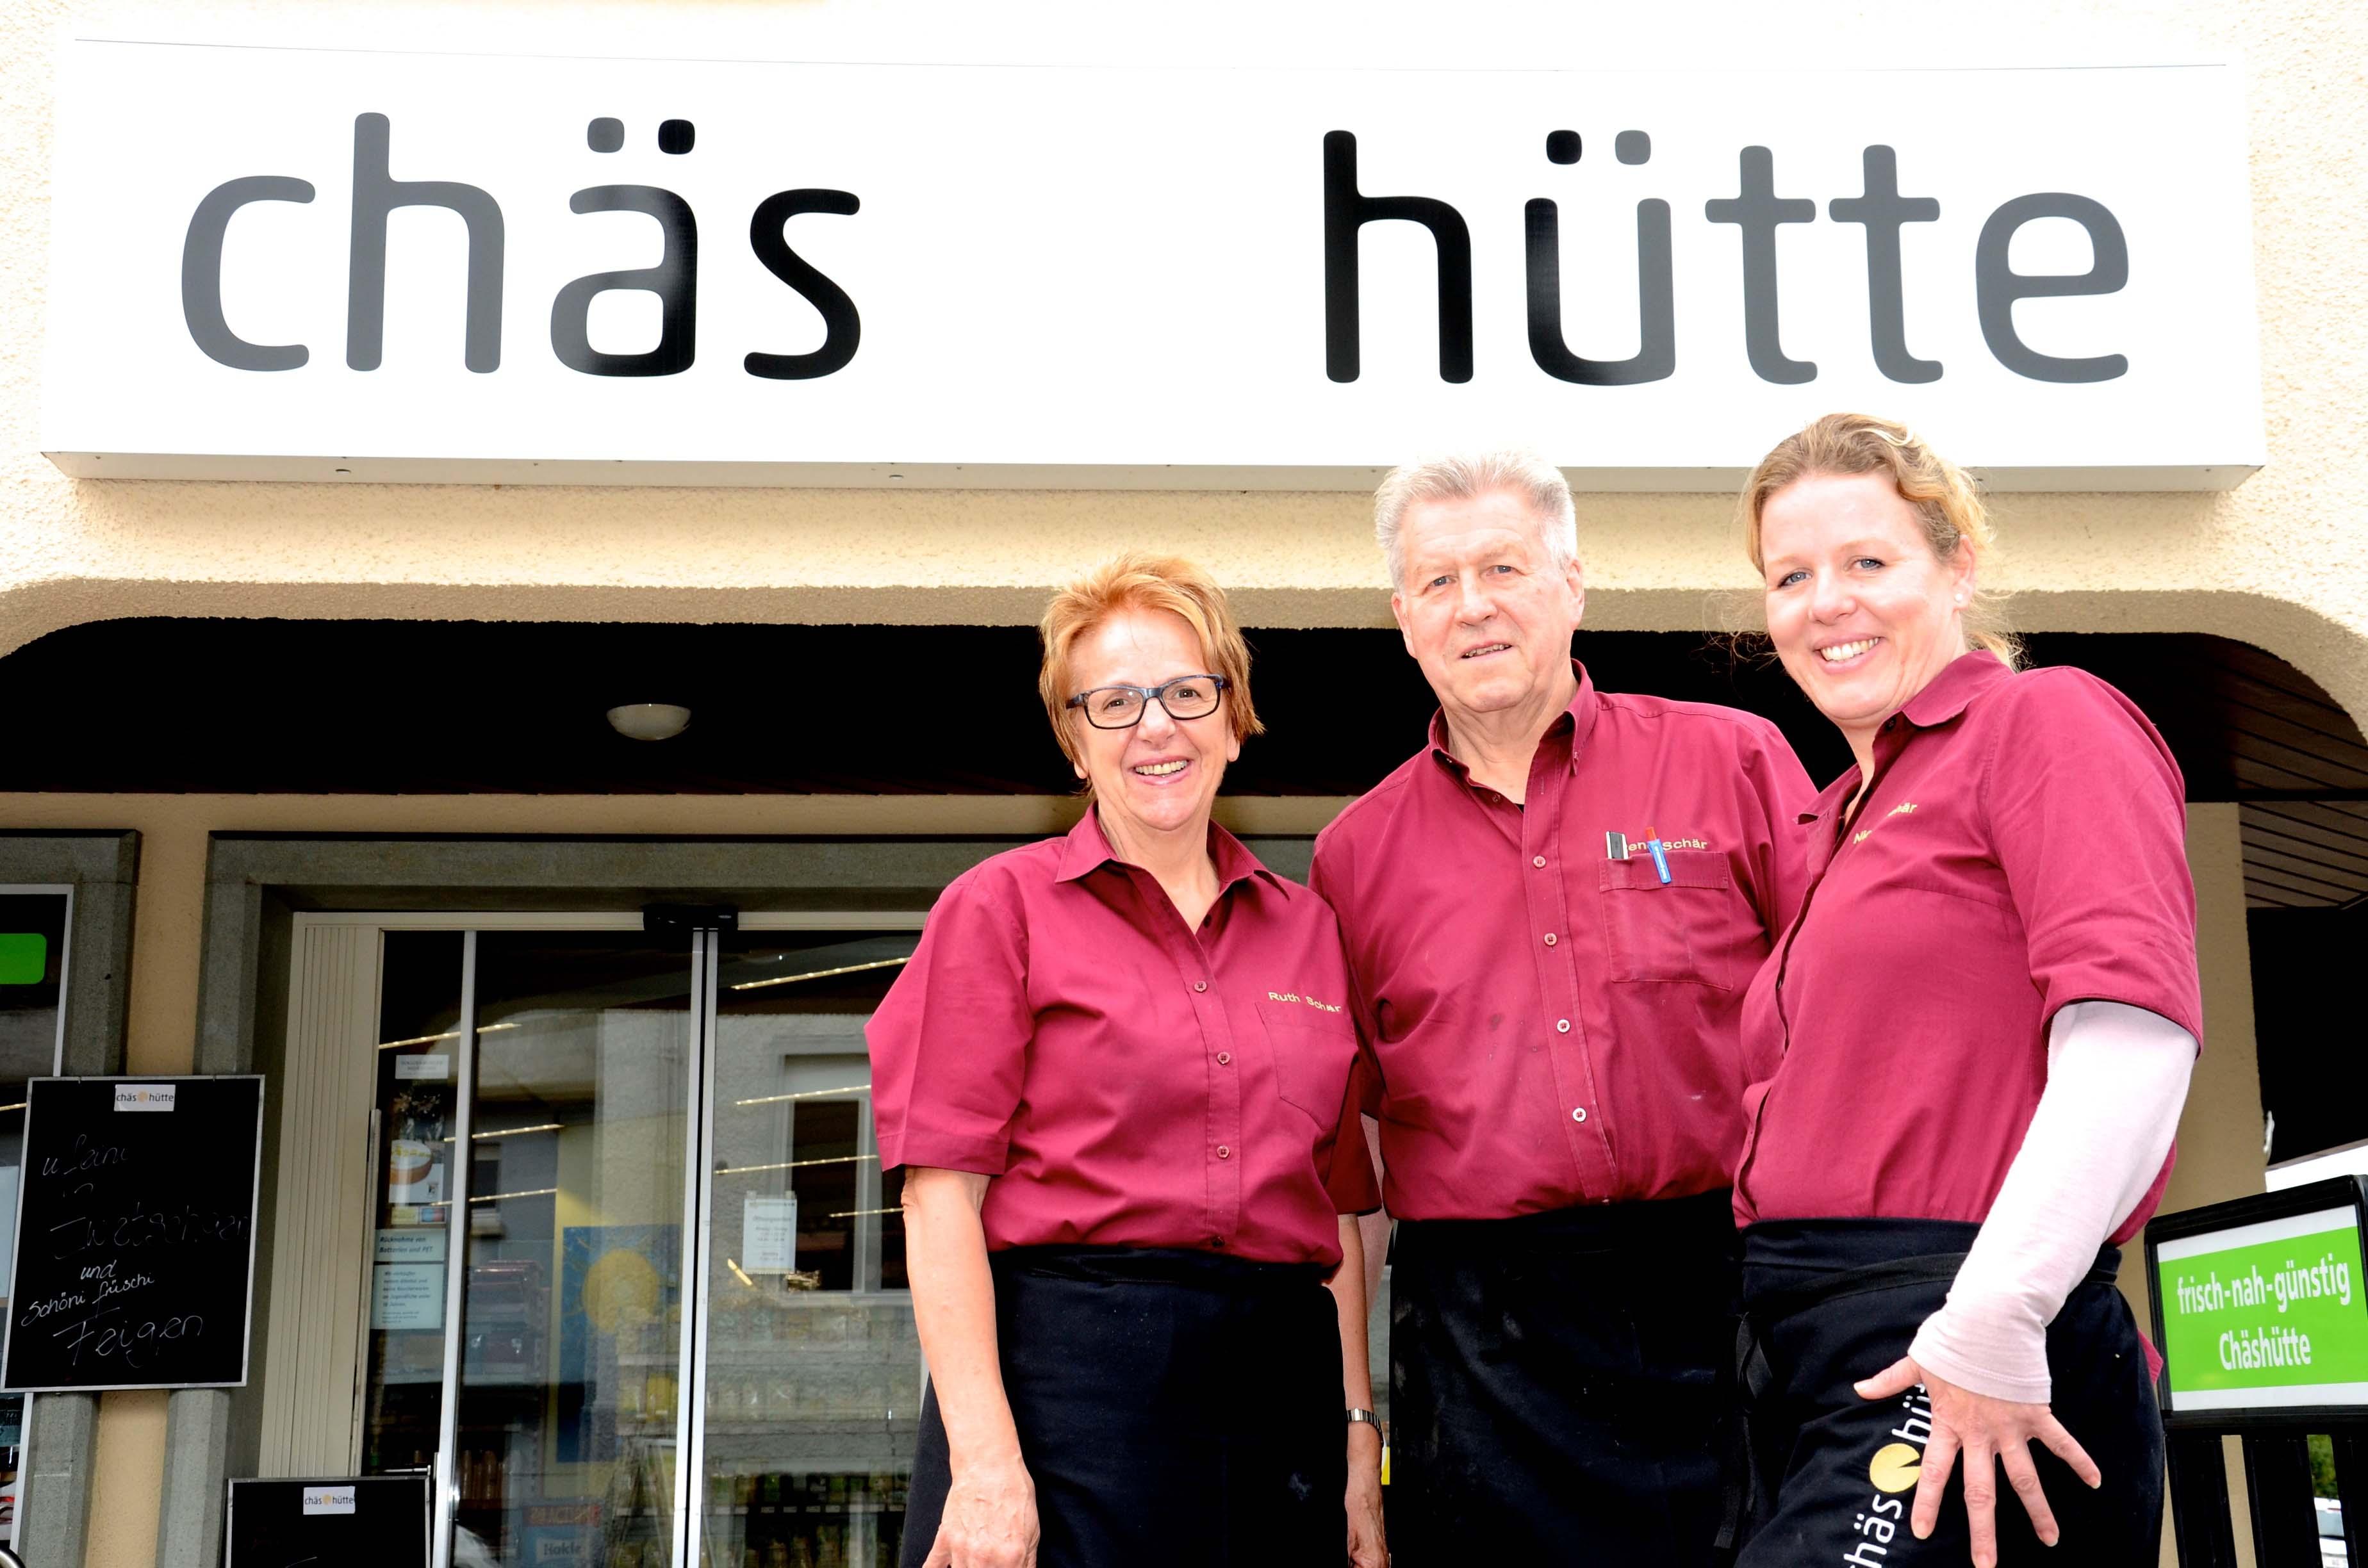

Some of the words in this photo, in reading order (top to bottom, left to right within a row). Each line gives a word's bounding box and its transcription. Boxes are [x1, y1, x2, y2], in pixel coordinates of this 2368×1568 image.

[182, 113, 860, 377] chäs
[1324, 130, 2128, 386] hütte
[1268, 992, 1300, 1003] Ruth
[116, 1092, 137, 1102] chäs
[149, 1092, 174, 1103] hütte
[81, 1259, 118, 1281] und
[2177, 1253, 2351, 1314] frisch-nah-günstig
[53, 1307, 204, 1368] Feigen
[2219, 1327, 2312, 1371] Chäshütte
[304, 1496, 322, 1505] chäs
[332, 1496, 354, 1505] hütte
[1843, 1494, 1902, 1568] häs
